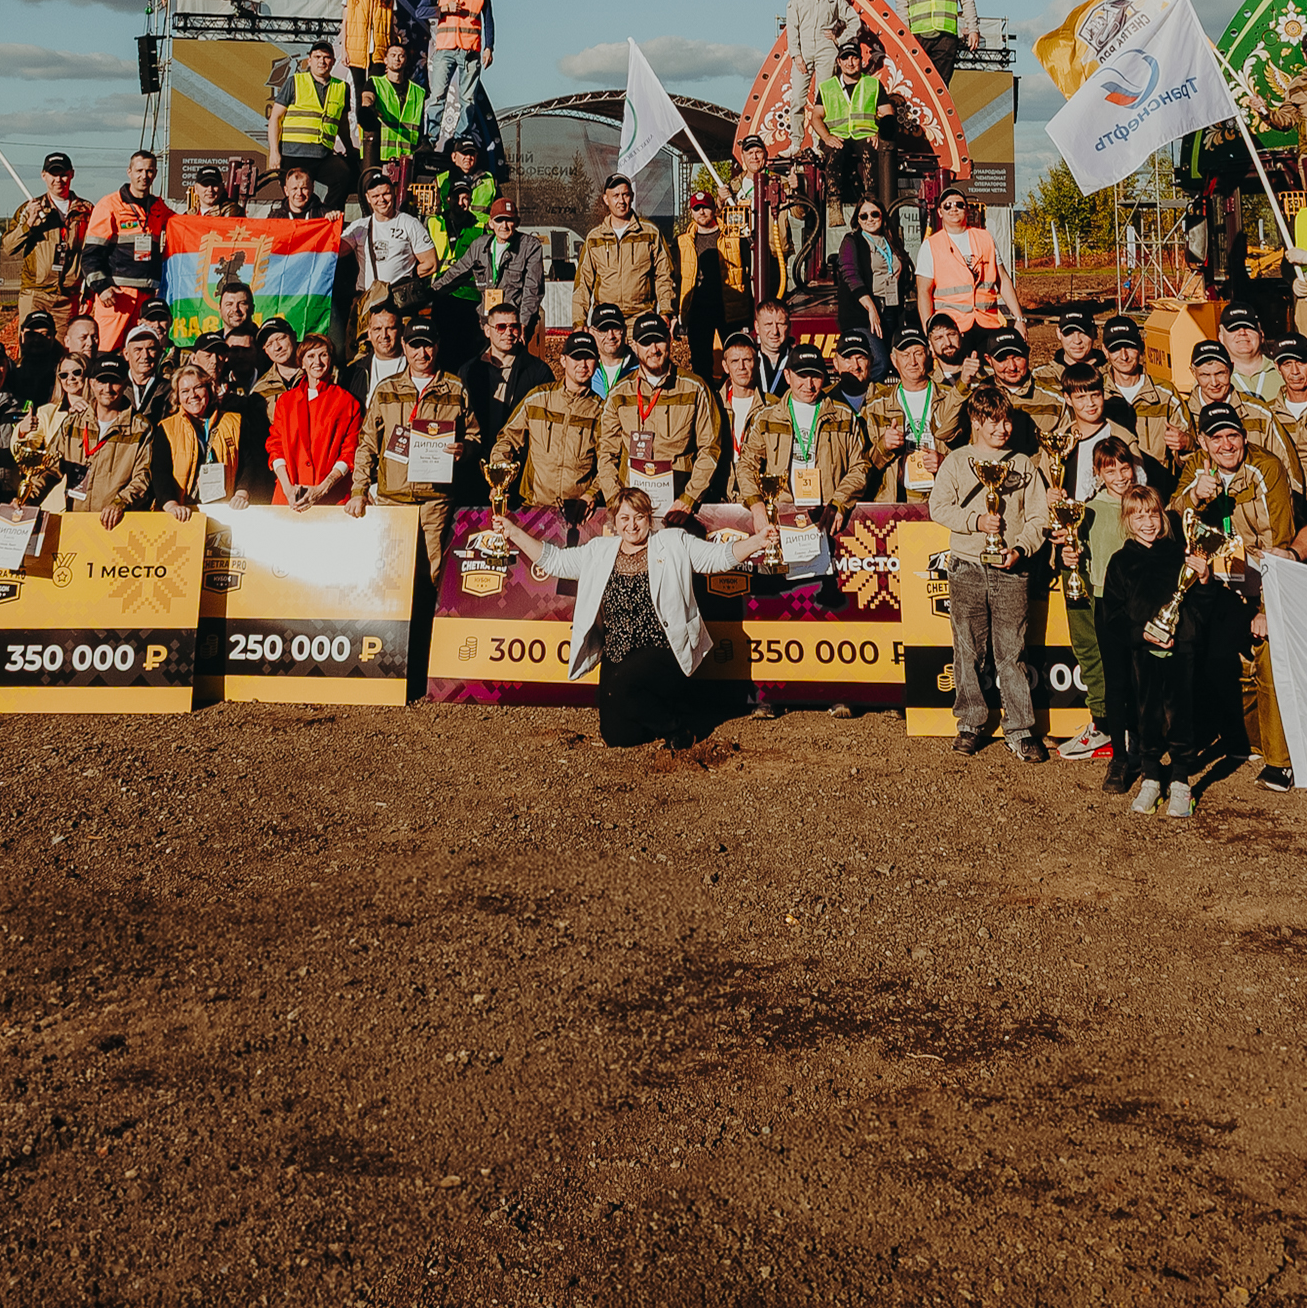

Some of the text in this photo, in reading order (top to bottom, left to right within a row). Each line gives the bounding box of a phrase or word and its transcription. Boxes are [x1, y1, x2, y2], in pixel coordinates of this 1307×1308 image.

[508, 166, 578, 176] РОФЕССИИ
[634, 479, 670, 488] ДИПЛОМ
[802, 479, 812, 487] 31
[86, 562, 167, 579] 1 место
[232, 560, 247, 570] PRO
[229, 634, 283, 661] 250
[291, 635, 351, 662] 000
[488, 637, 546, 663] 300
[747, 639, 804, 663] 350
[815, 640, 879, 665] 000
[4, 644, 64, 672] 350
[72, 644, 135, 672] 000
